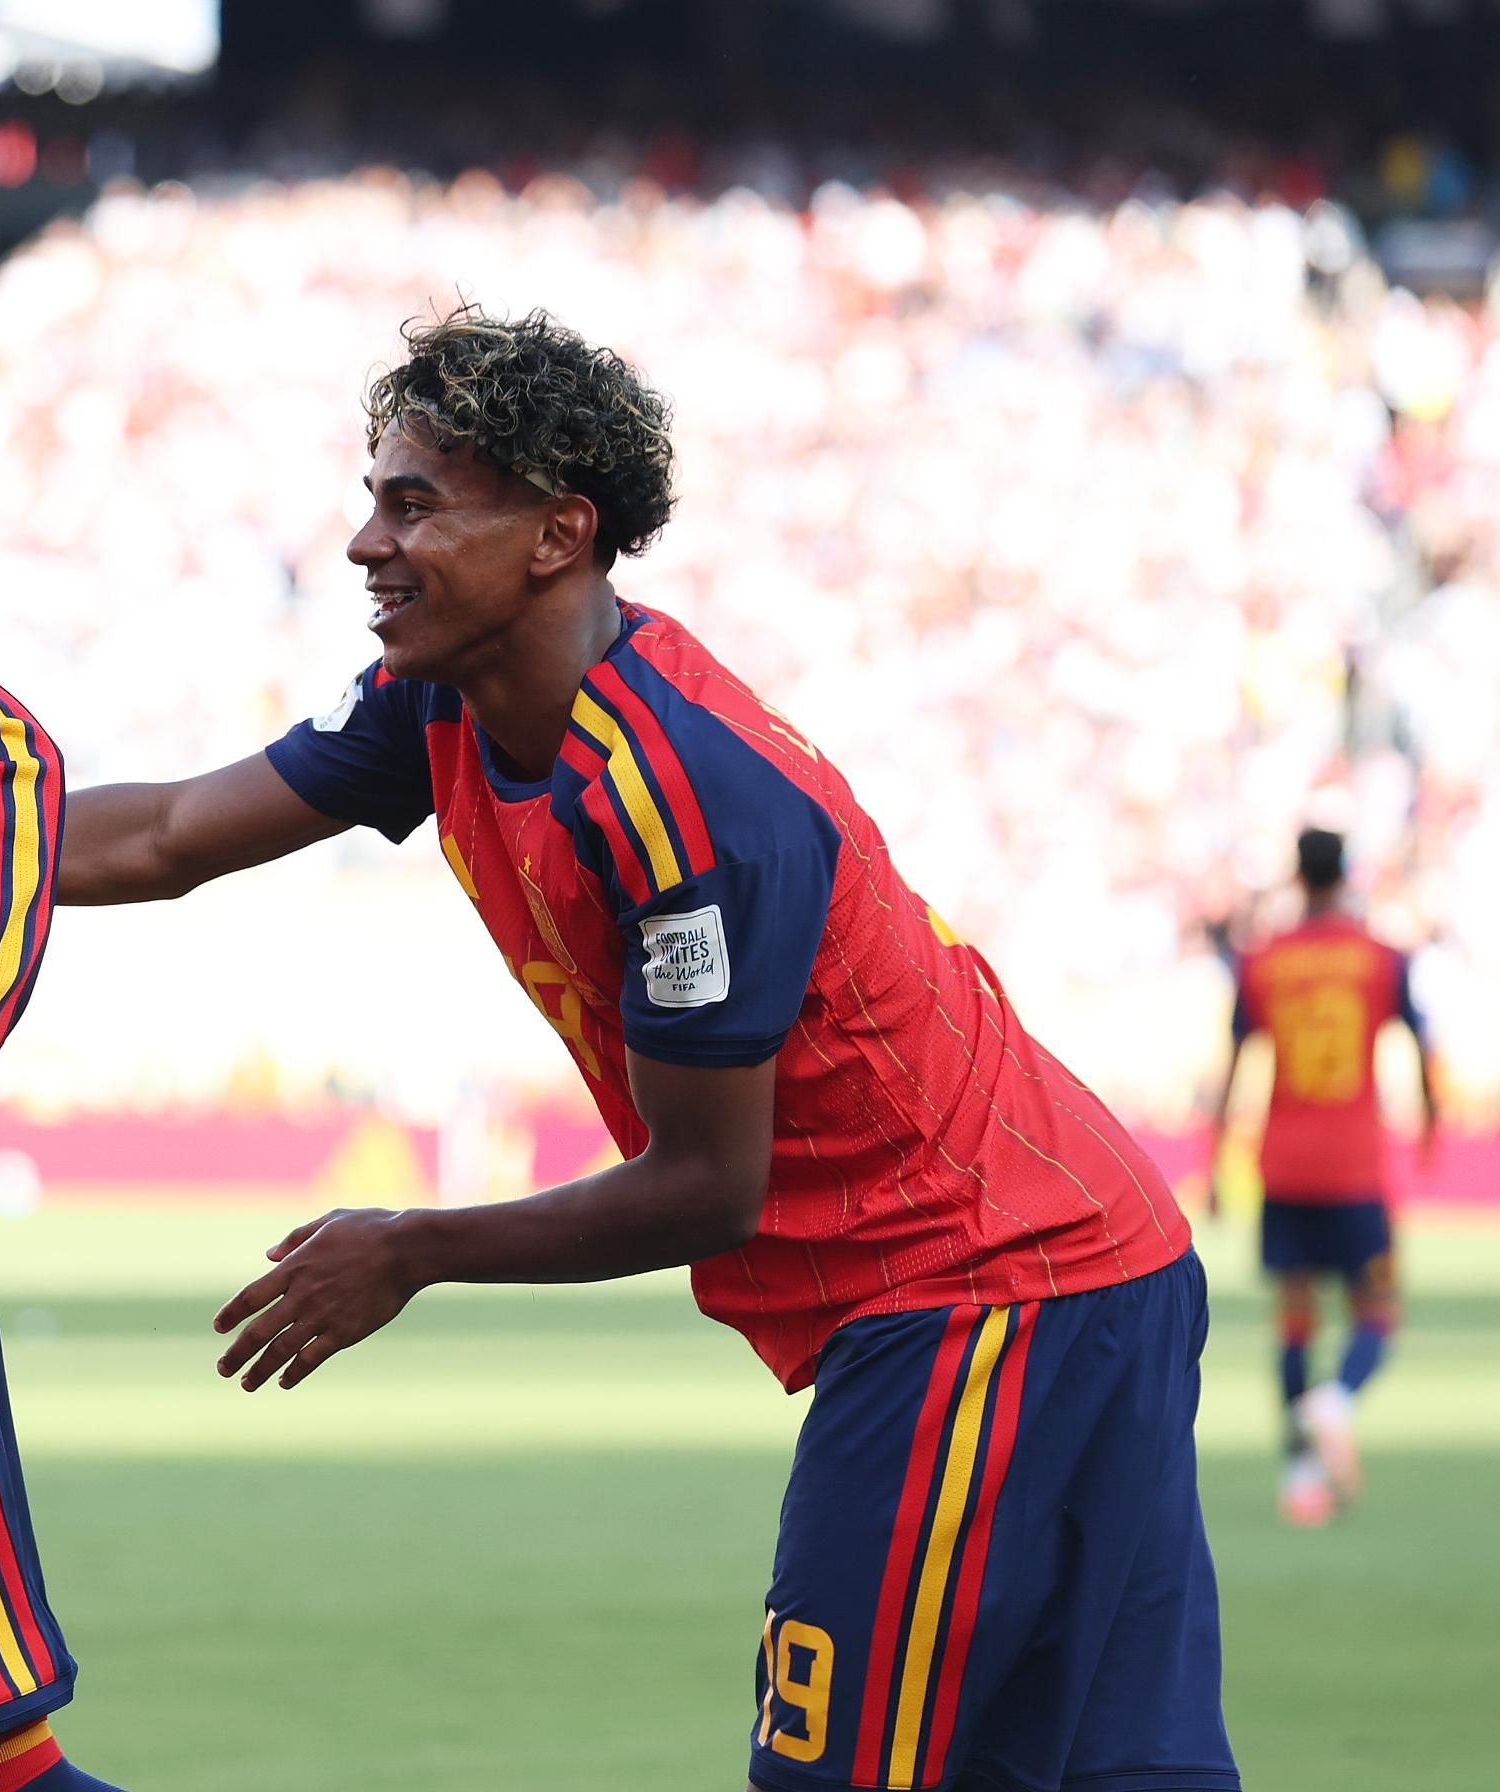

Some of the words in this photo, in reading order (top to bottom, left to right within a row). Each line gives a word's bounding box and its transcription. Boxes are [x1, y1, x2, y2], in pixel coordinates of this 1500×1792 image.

[655, 926, 707, 945] FOOTBALL
[652, 964, 674, 980] the
[675, 958, 714, 981] World
[672, 982, 696, 991] FIFA
[757, 1607, 835, 1763] 19
